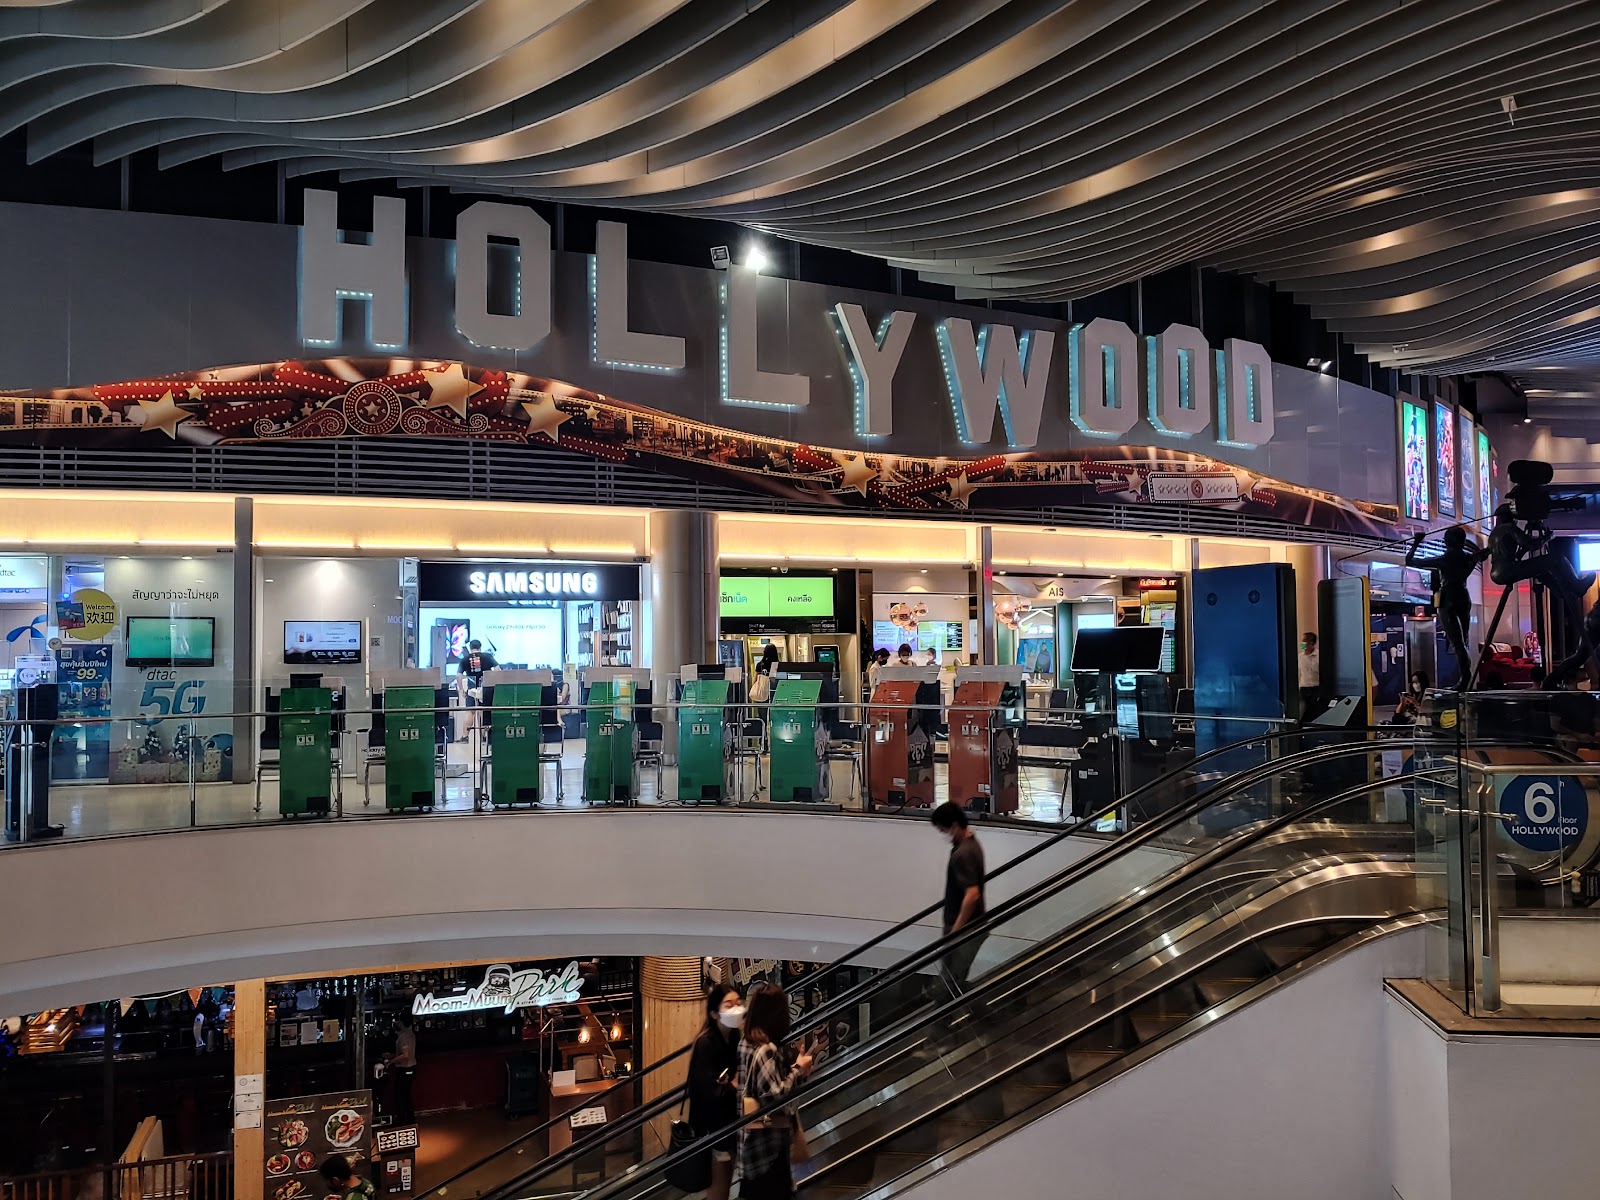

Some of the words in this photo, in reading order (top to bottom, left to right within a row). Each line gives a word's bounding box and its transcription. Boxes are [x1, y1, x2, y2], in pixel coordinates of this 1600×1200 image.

[302, 187, 1275, 448] HOLLYWOOD
[469, 571, 598, 594] SAMSUNG
[132, 588, 219, 602] สัญญาว่าจะไม่หยุด
[1048, 587, 1064, 597] AIS
[86, 612, 114, 624] 欢迎
[146, 668, 177, 681] dtac
[136, 680, 207, 720] 5G
[1524, 781, 1556, 824] 6
[1511, 826, 1579, 836] HOLLYWOOD
[510, 965, 581, 1010] Park
